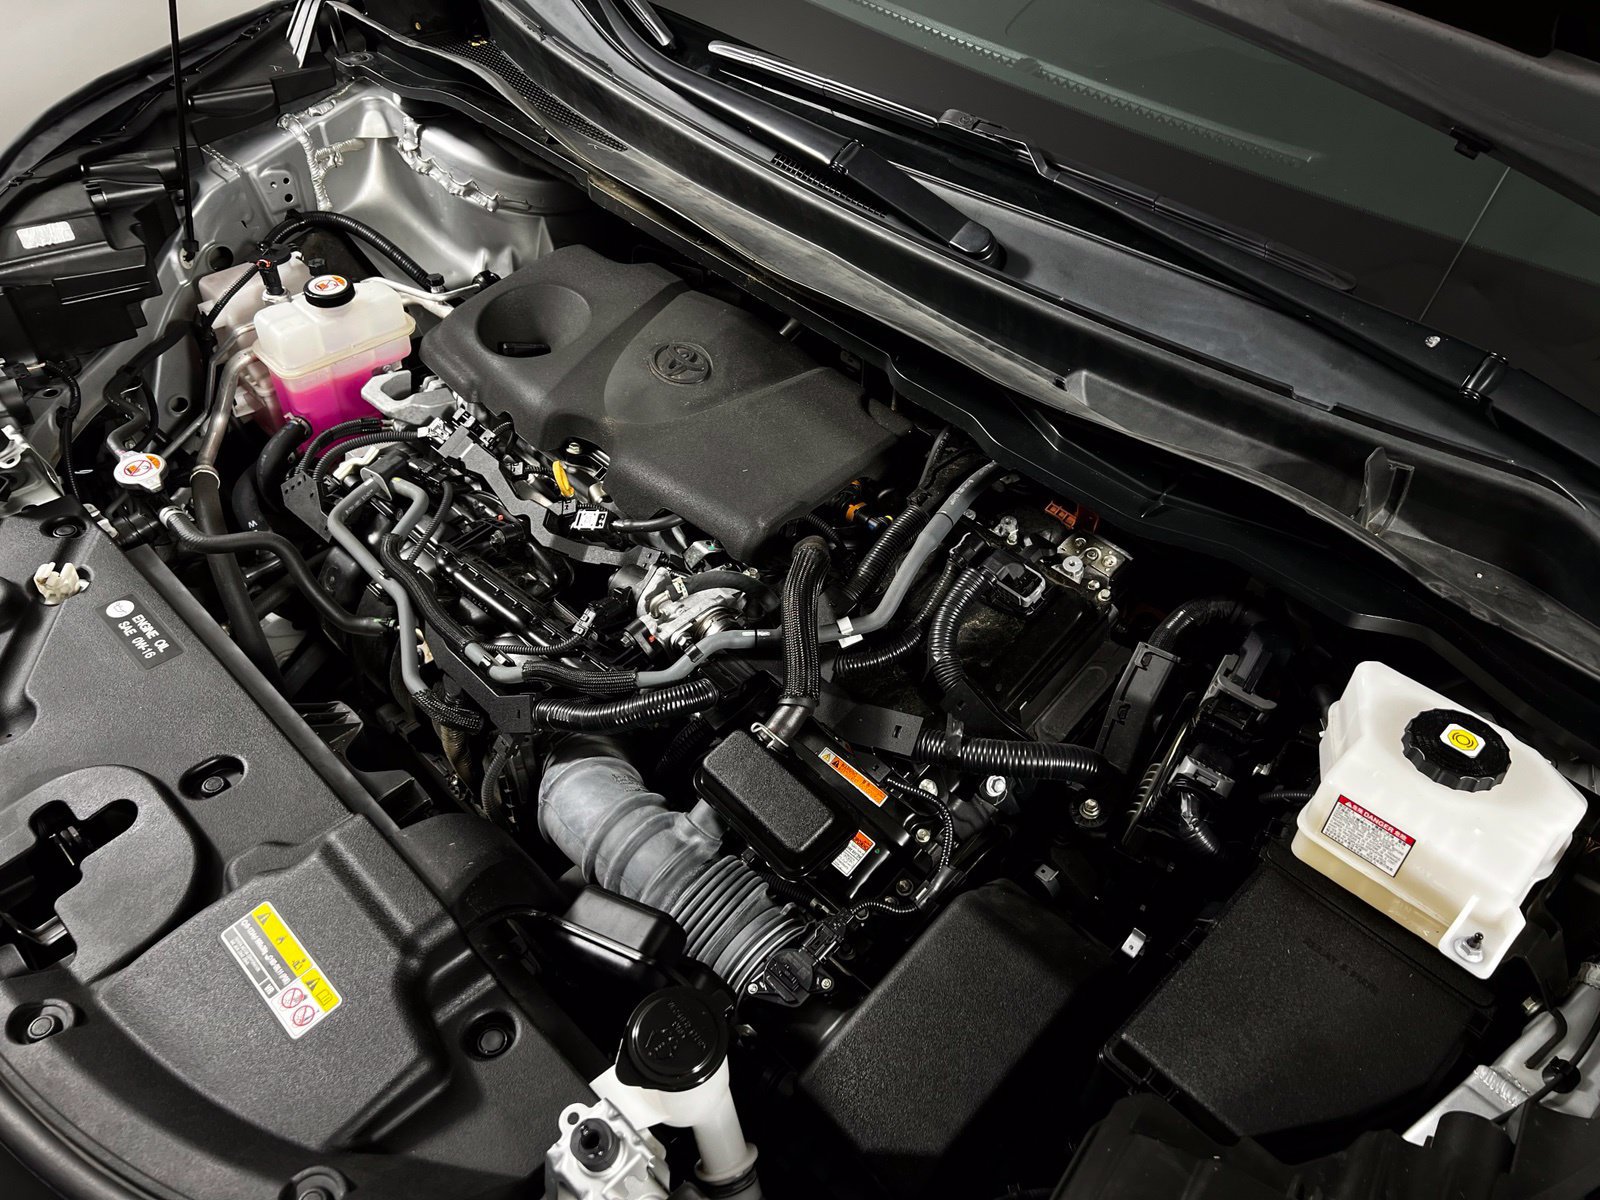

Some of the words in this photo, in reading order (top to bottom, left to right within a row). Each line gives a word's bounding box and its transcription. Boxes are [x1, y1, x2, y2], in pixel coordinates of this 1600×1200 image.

[118, 621, 137, 637] SAE
[131, 636, 156, 659] 0W-16
[132, 614, 160, 640] ENGINE
[154, 639, 170, 653] OIL
[1363, 811, 1395, 834] DANGER
